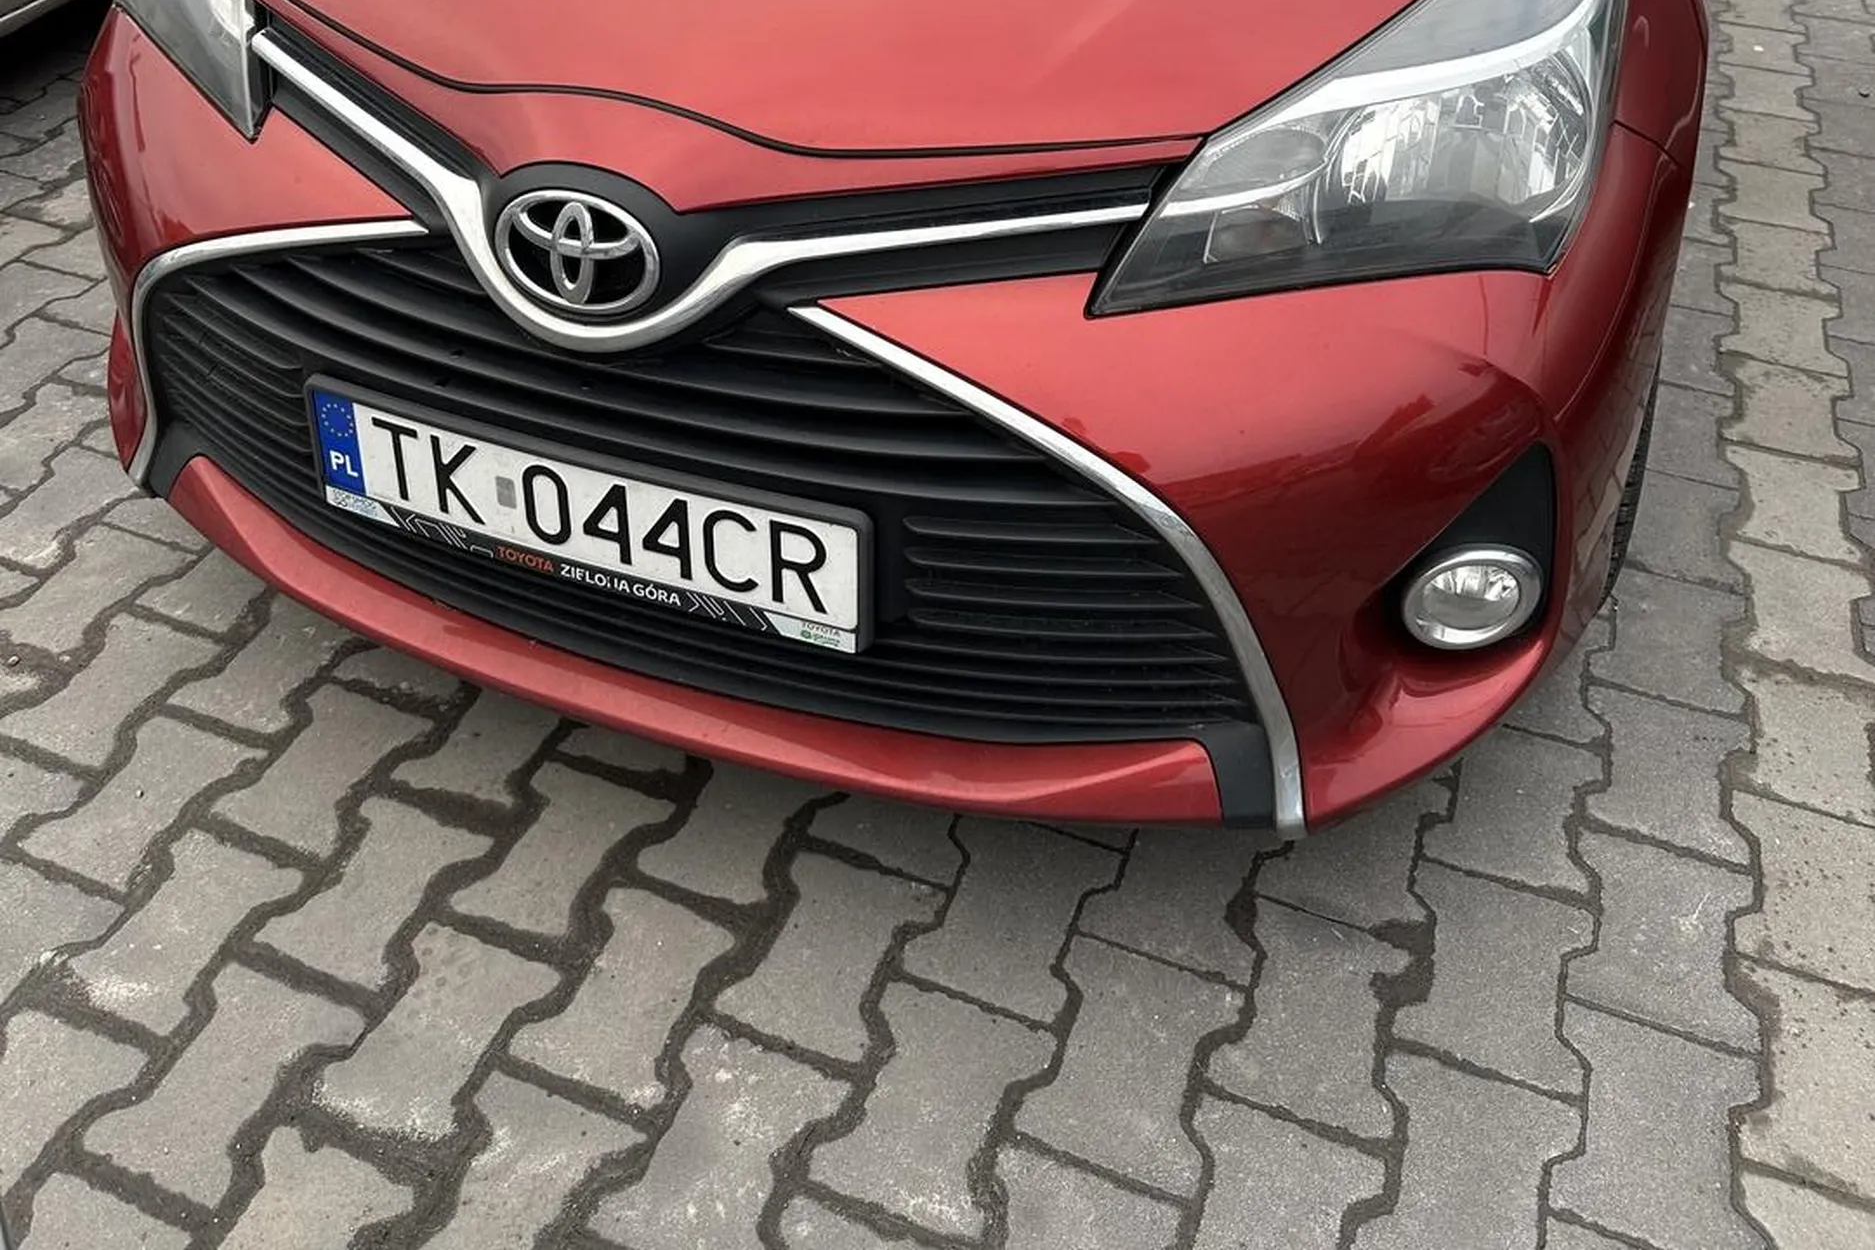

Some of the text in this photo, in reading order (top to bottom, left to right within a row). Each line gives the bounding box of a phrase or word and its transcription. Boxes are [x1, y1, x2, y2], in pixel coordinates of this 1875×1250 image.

[329, 450, 358, 478] PL
[371, 416, 828, 614] TK 044CR
[497, 547, 554, 573] TOYOTA
[633, 582, 682, 607] GÓRA
